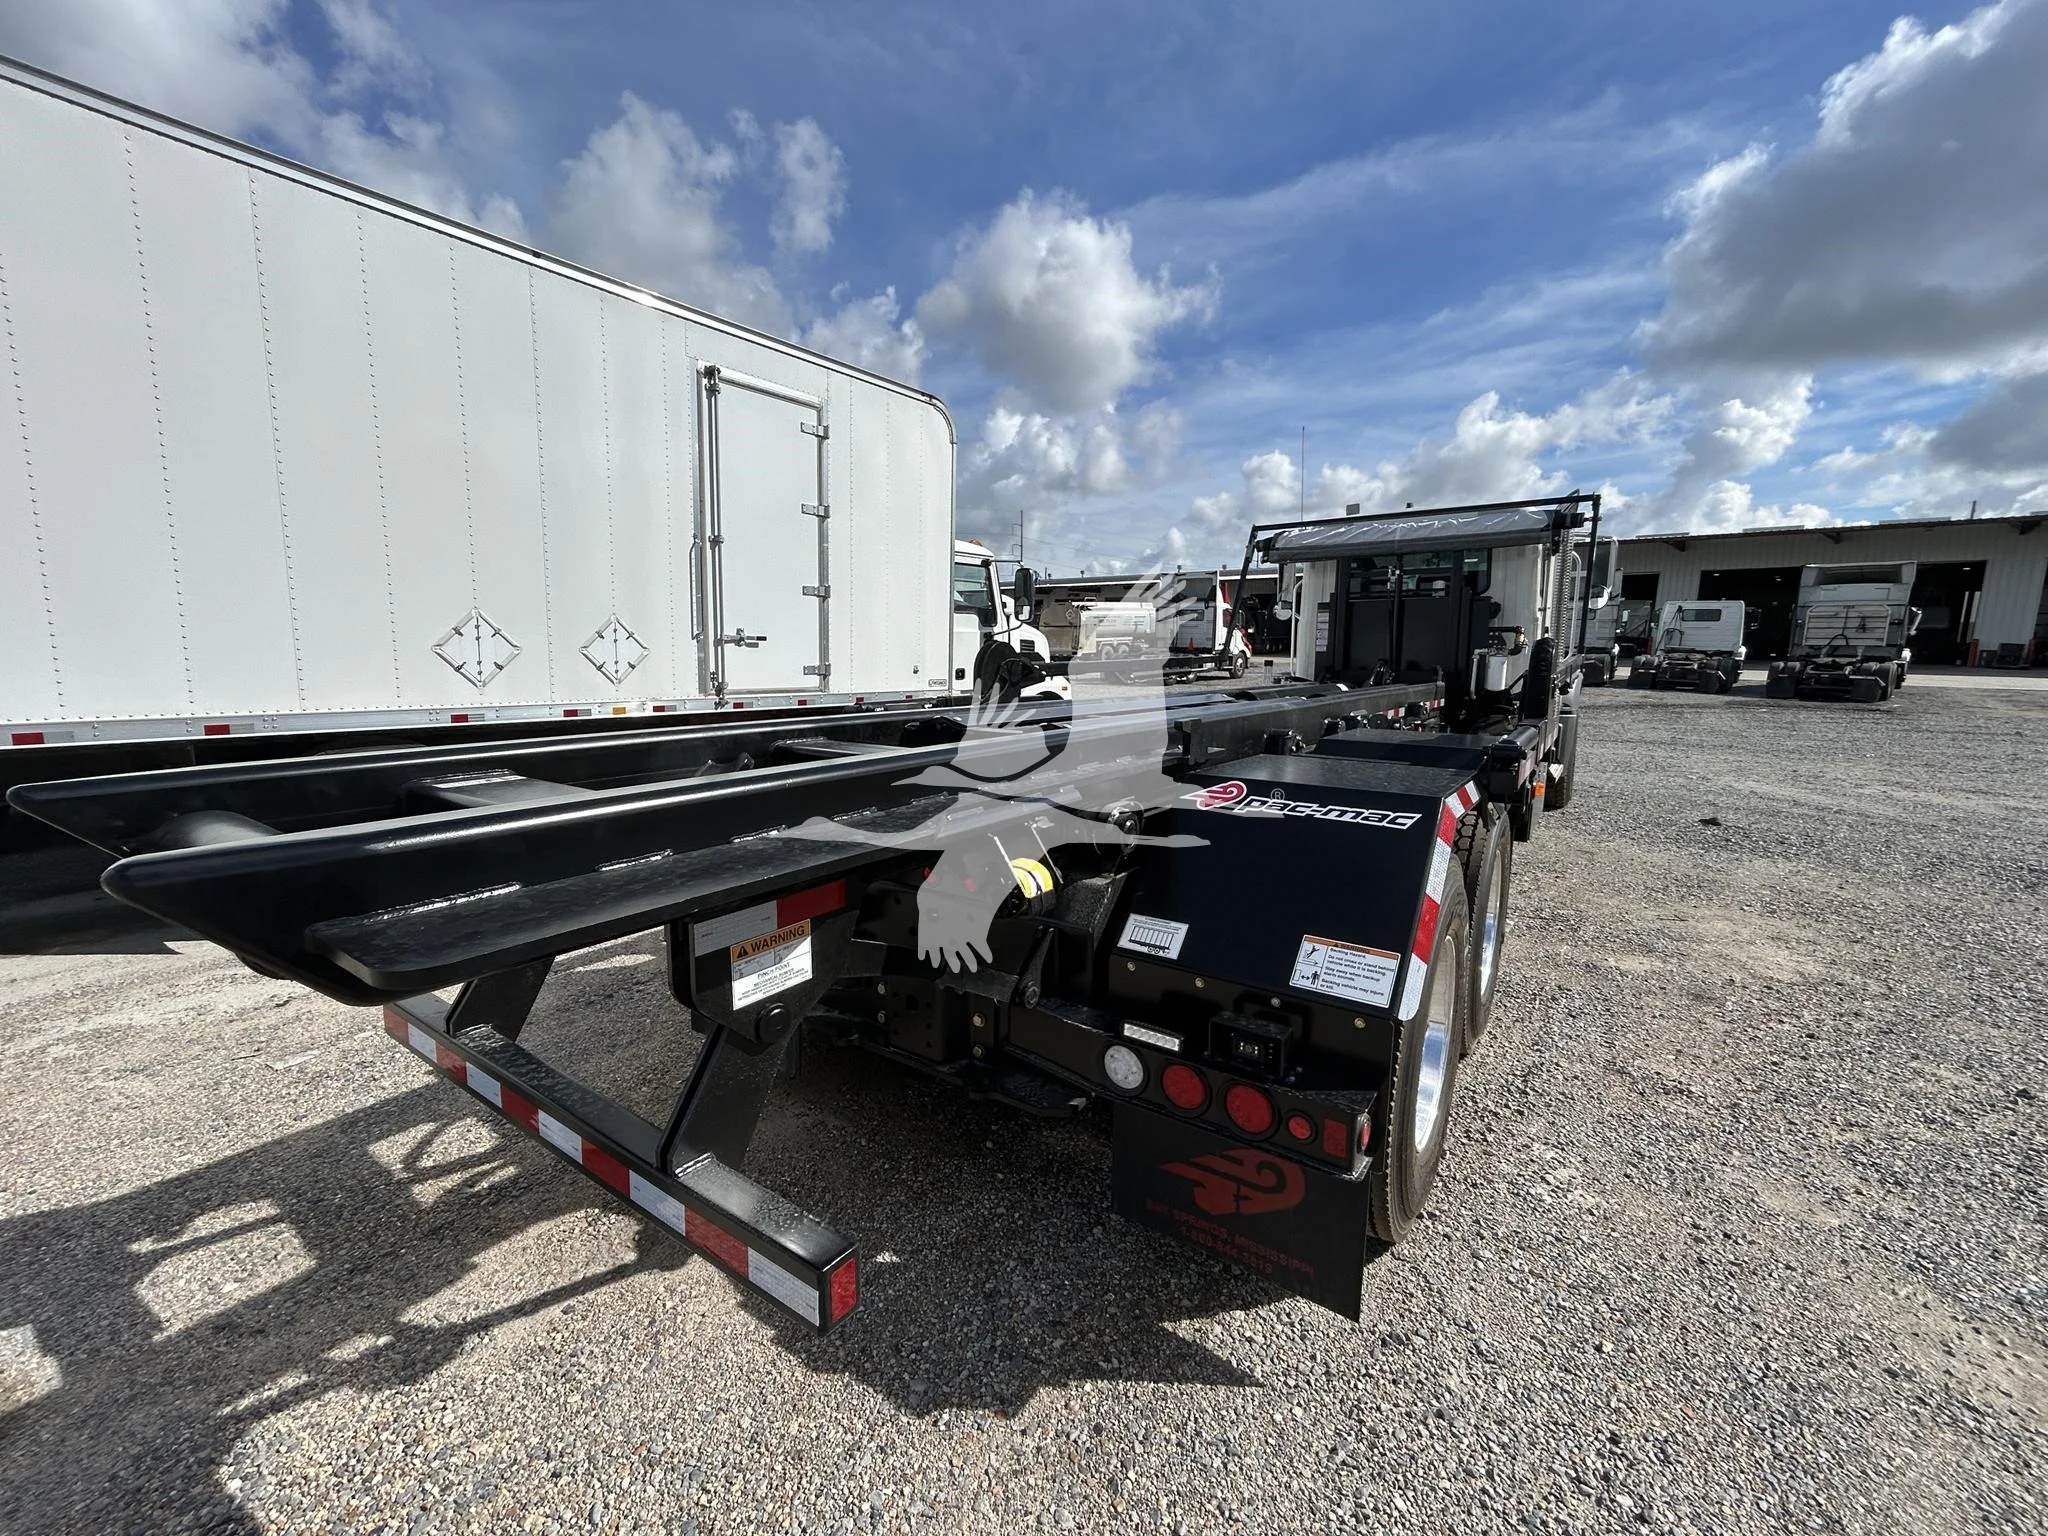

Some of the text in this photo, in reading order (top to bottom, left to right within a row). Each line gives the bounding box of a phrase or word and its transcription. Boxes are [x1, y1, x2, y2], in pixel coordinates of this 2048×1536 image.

[1233, 796, 1422, 829] pac-mac
[751, 925, 805, 953] WARNING
[757, 962, 790, 979] PINCH POINT
[1321, 979, 1340, 987] Backing
[1341, 983, 1357, 991] vehicle
[1370, 990, 1384, 998] injure
